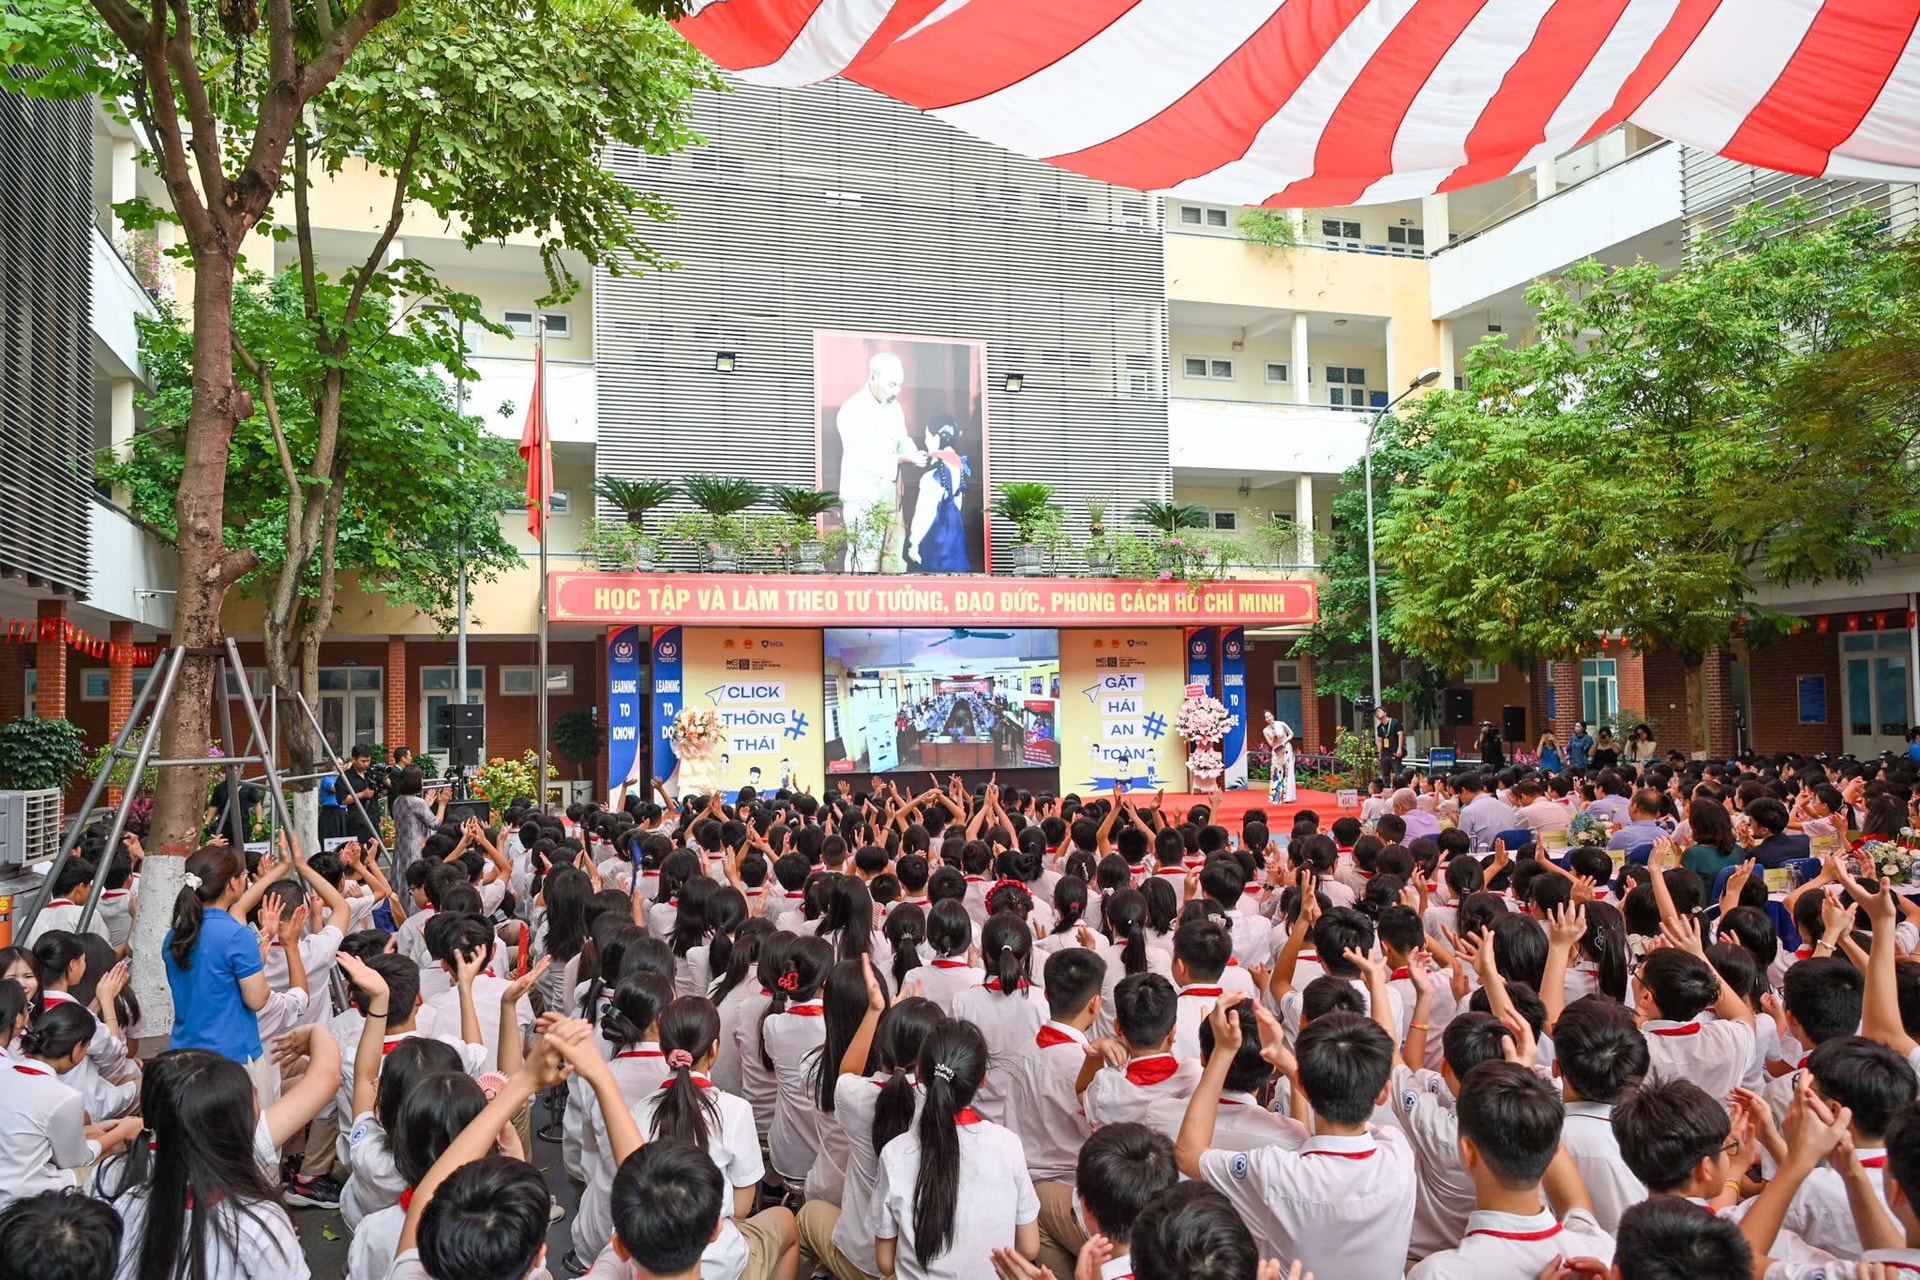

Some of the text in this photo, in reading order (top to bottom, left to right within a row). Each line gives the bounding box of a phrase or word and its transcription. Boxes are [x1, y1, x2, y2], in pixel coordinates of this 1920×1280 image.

[594, 588, 641, 615] HỌC
[648, 584, 690, 615] TẬP
[697, 585, 726, 611] VÀ
[733, 586, 779, 611] LÀM
[786, 590, 838, 612] THEO
[844, 589, 871, 612] TƯ
[876, 584, 949, 614] TƯỞNG,
[955, 591, 995, 616] ĐẠO
[1000, 588, 1045, 614] ĐỨC,
[1051, 592, 1115, 613] PHONG
[1121, 589, 1169, 612] CÁCH
[1204, 589, 1234, 612] CHÍ
[1239, 594, 1285, 612] MINH
[612, 680, 636, 693] LEARNING
[656, 680, 680, 693] LEARNING
[1105, 674, 1137, 691] GẶT
[1224, 674, 1243, 686] LEARNING
[728, 686, 780, 698] CLICK
[1108, 698, 1135, 712] HÁI
[1230, 694, 1239, 706] TO
[619, 703, 630, 717] TO
[663, 703, 673, 716] TO
[722, 710, 786, 725] THÔNG
[613, 726, 636, 740] KNOW
[1111, 724, 1134, 735] AN
[733, 736, 775, 751] THÁI
[1103, 746, 1145, 760] TOÀN
